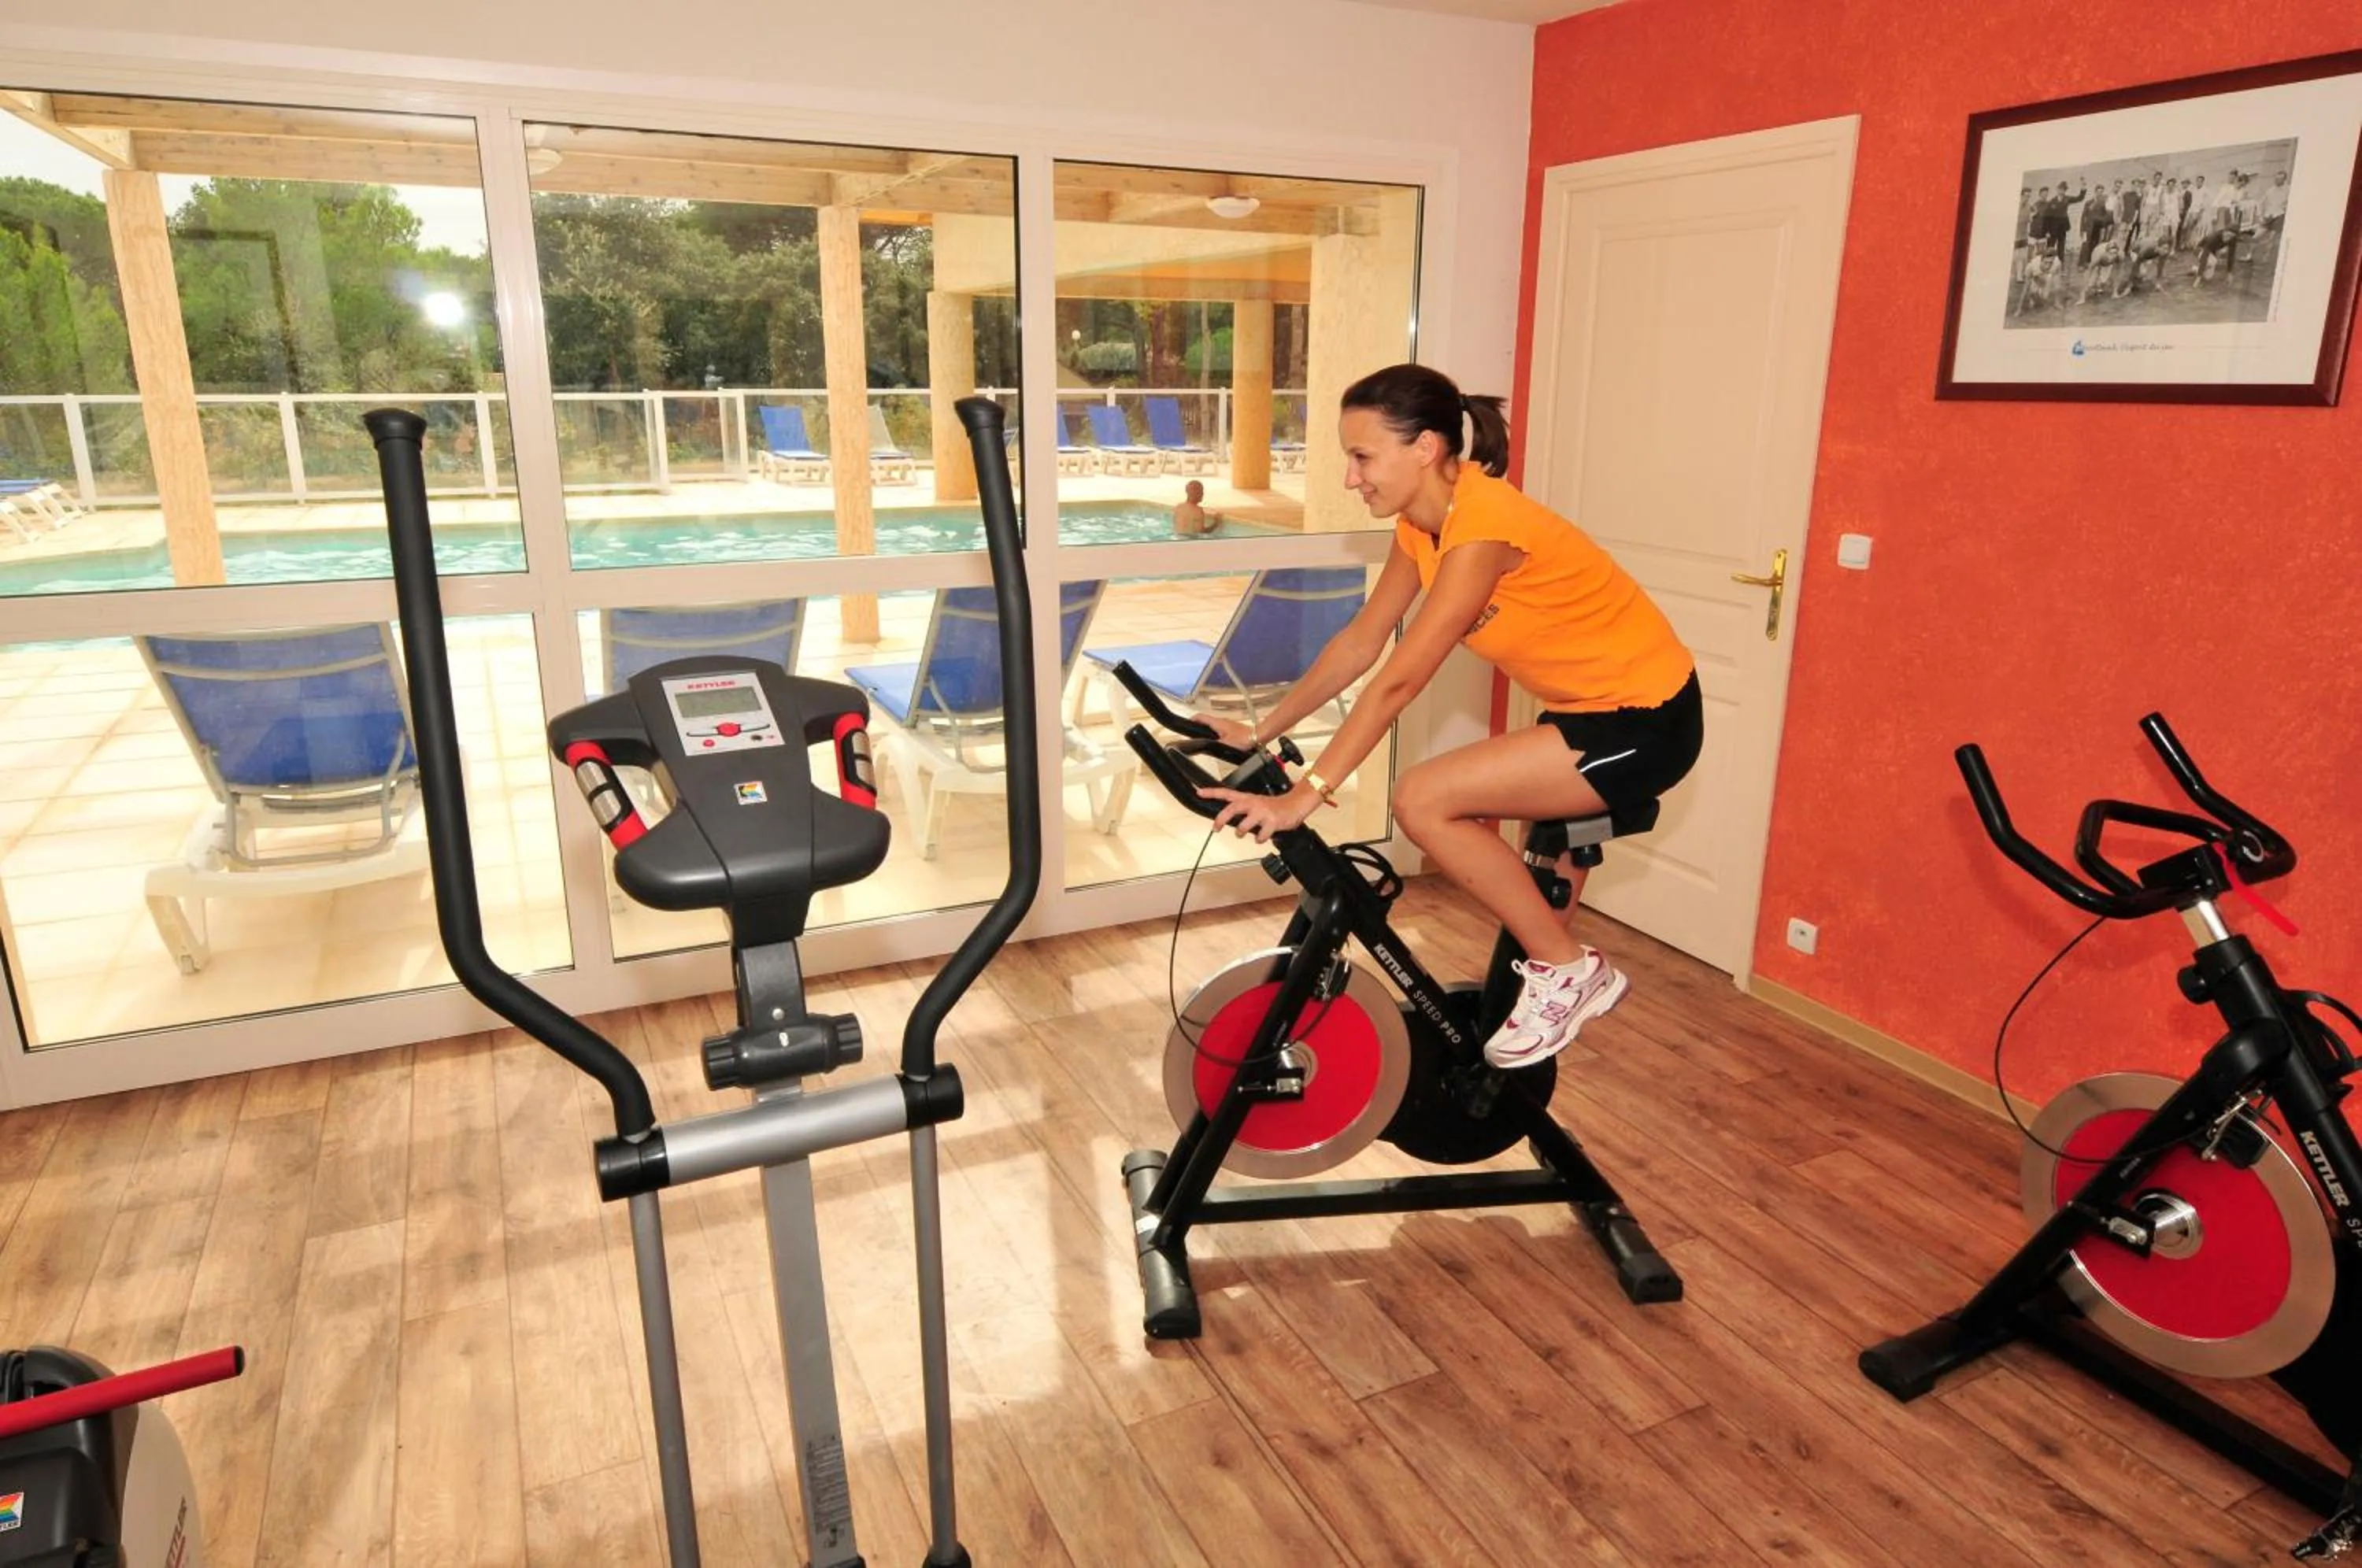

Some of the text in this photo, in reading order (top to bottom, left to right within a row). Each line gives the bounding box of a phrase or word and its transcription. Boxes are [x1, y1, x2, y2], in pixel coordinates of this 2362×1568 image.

[1373, 943, 1462, 1044] KETTLER SPEED PRO
[2299, 1130, 2351, 1207] KETTLER
